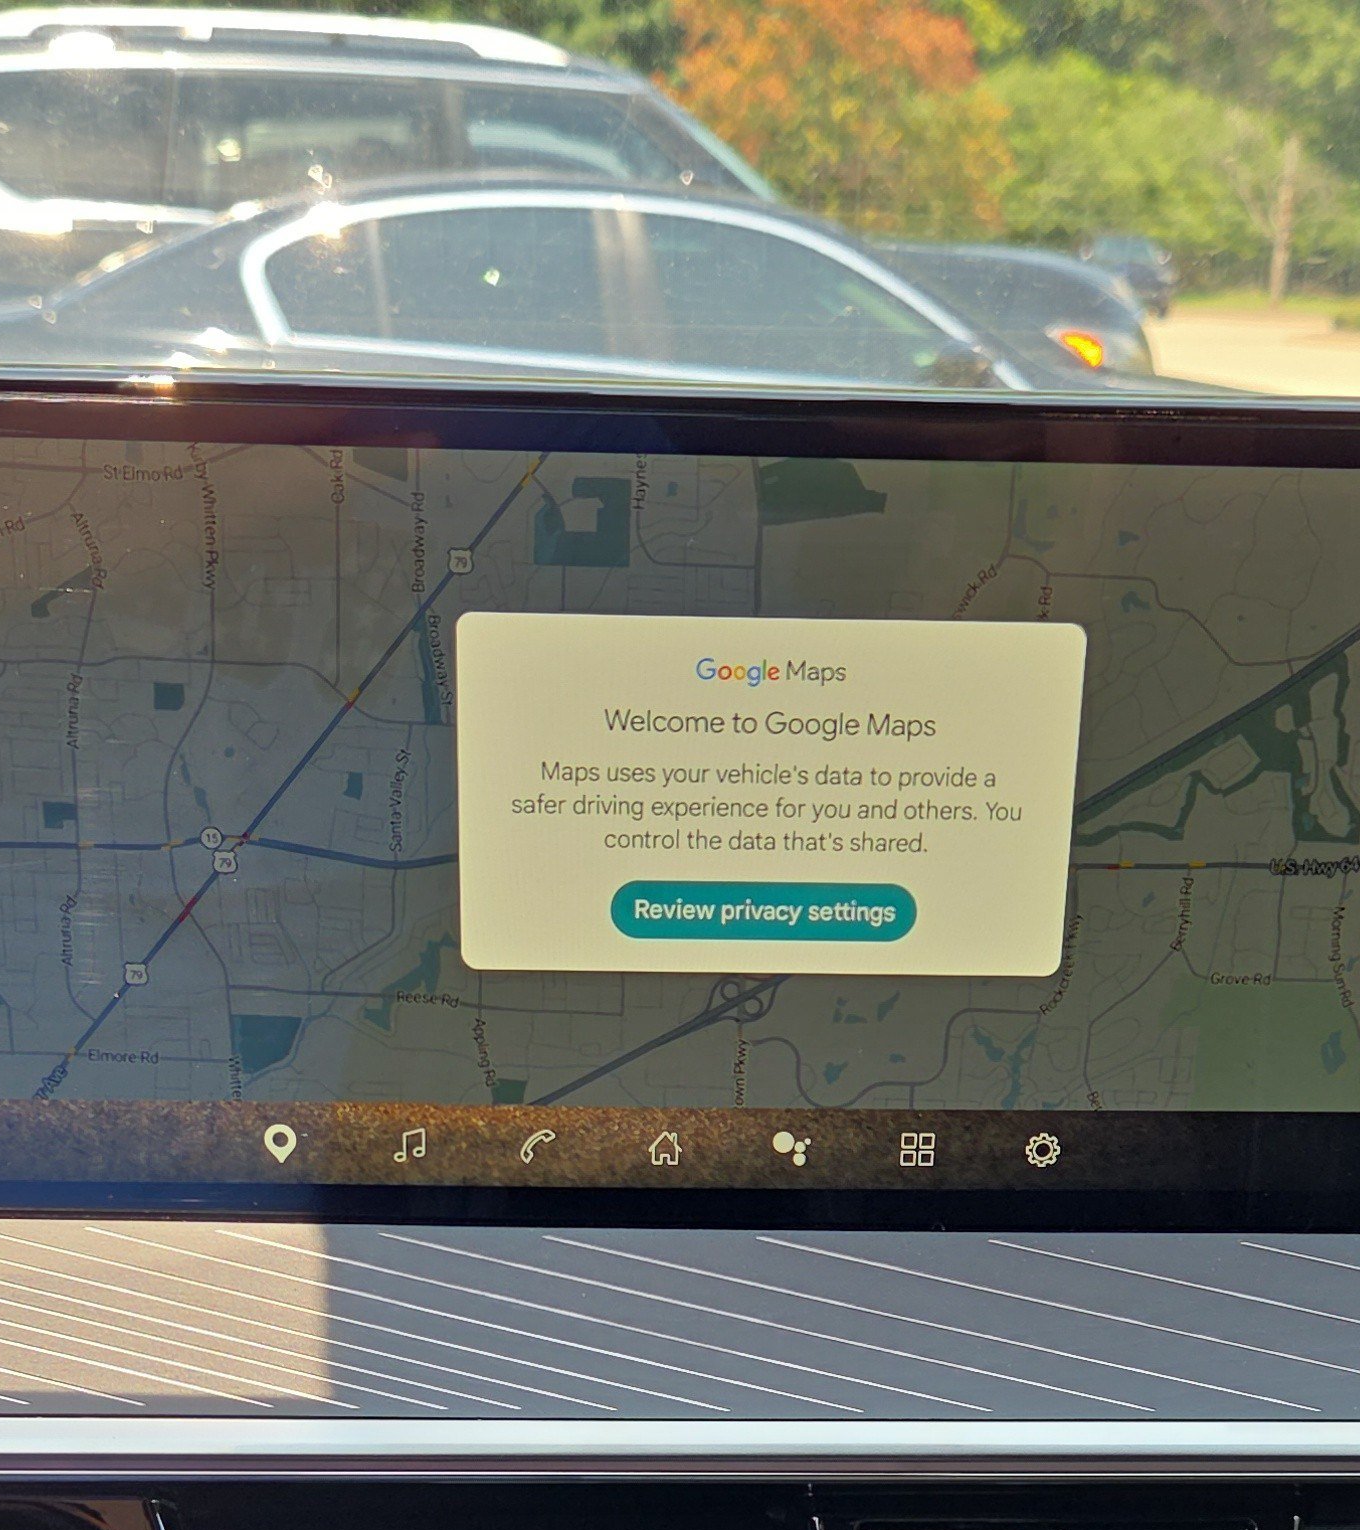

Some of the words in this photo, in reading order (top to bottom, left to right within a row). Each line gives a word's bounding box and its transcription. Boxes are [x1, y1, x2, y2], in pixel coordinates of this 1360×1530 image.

[329, 449, 344, 470] Rd
[103, 464, 119, 481] St
[163, 465, 183, 481] Rd
[411, 491, 425, 513] Rd
[4, 516, 26, 535] Rd
[201, 483, 217, 547] Whitten
[411, 514, 428, 594] Broadway
[91, 567, 107, 590] Rd
[201, 550, 220, 590] Pkwy
[977, 563, 997, 582] Rd
[1038, 586, 1052, 606] Rd
[427, 614, 449, 688] Broadway
[67, 673, 83, 695] Rd
[696, 657, 780, 688] Google
[786, 659, 847, 687] Maps
[604, 708, 725, 733] Welcome
[732, 713, 758, 734] to
[764, 711, 860, 742] Google
[866, 713, 937, 742] Maps
[395, 749, 411, 764] St
[388, 766, 409, 808] Valley
[541, 761, 600, 786] Maps
[607, 767, 656, 783] uses
[662, 768, 710, 788] your
[716, 763, 809, 785] vehicle's
[815, 764, 863, 786] data
[870, 766, 892, 787] to
[898, 766, 977, 791] provide
[984, 772, 996, 788] a
[511, 794, 566, 815] safer
[573, 794, 644, 821] driving
[651, 796, 769, 821] experience
[776, 797, 806, 818] for
[812, 803, 851, 823] you
[857, 799, 898, 820] and
[904, 799, 977, 820] others.
[986, 801, 1022, 821] You
[389, 811, 402, 852] Santa
[604, 829, 680, 849] control
[687, 829, 722, 850] the
[728, 830, 776, 851] data
[783, 831, 843, 852] that's
[850, 831, 928, 853] shared.
[1301, 859, 1338, 879] Hwy
[1339, 855, 1360, 875] 64
[1180, 877, 1194, 896] Rd
[59, 894, 79, 916] Rd
[634, 898, 715, 919] Review
[721, 898, 803, 926] privacy
[808, 900, 896, 927] settings
[1328, 906, 1346, 962] Morning
[1338, 989, 1355, 1008] Rd
[1210, 971, 1249, 986] Grove
[1253, 972, 1272, 986] Rd
[396, 990, 437, 1005] Reese
[441, 992, 459, 1008] Rd
[88, 1049, 137, 1064] Elmore
[141, 1051, 159, 1064] Rd
[472, 1018, 490, 1068] Appling
[483, 1069, 496, 1087] Rd
[733, 1038, 749, 1074] Pkwy
